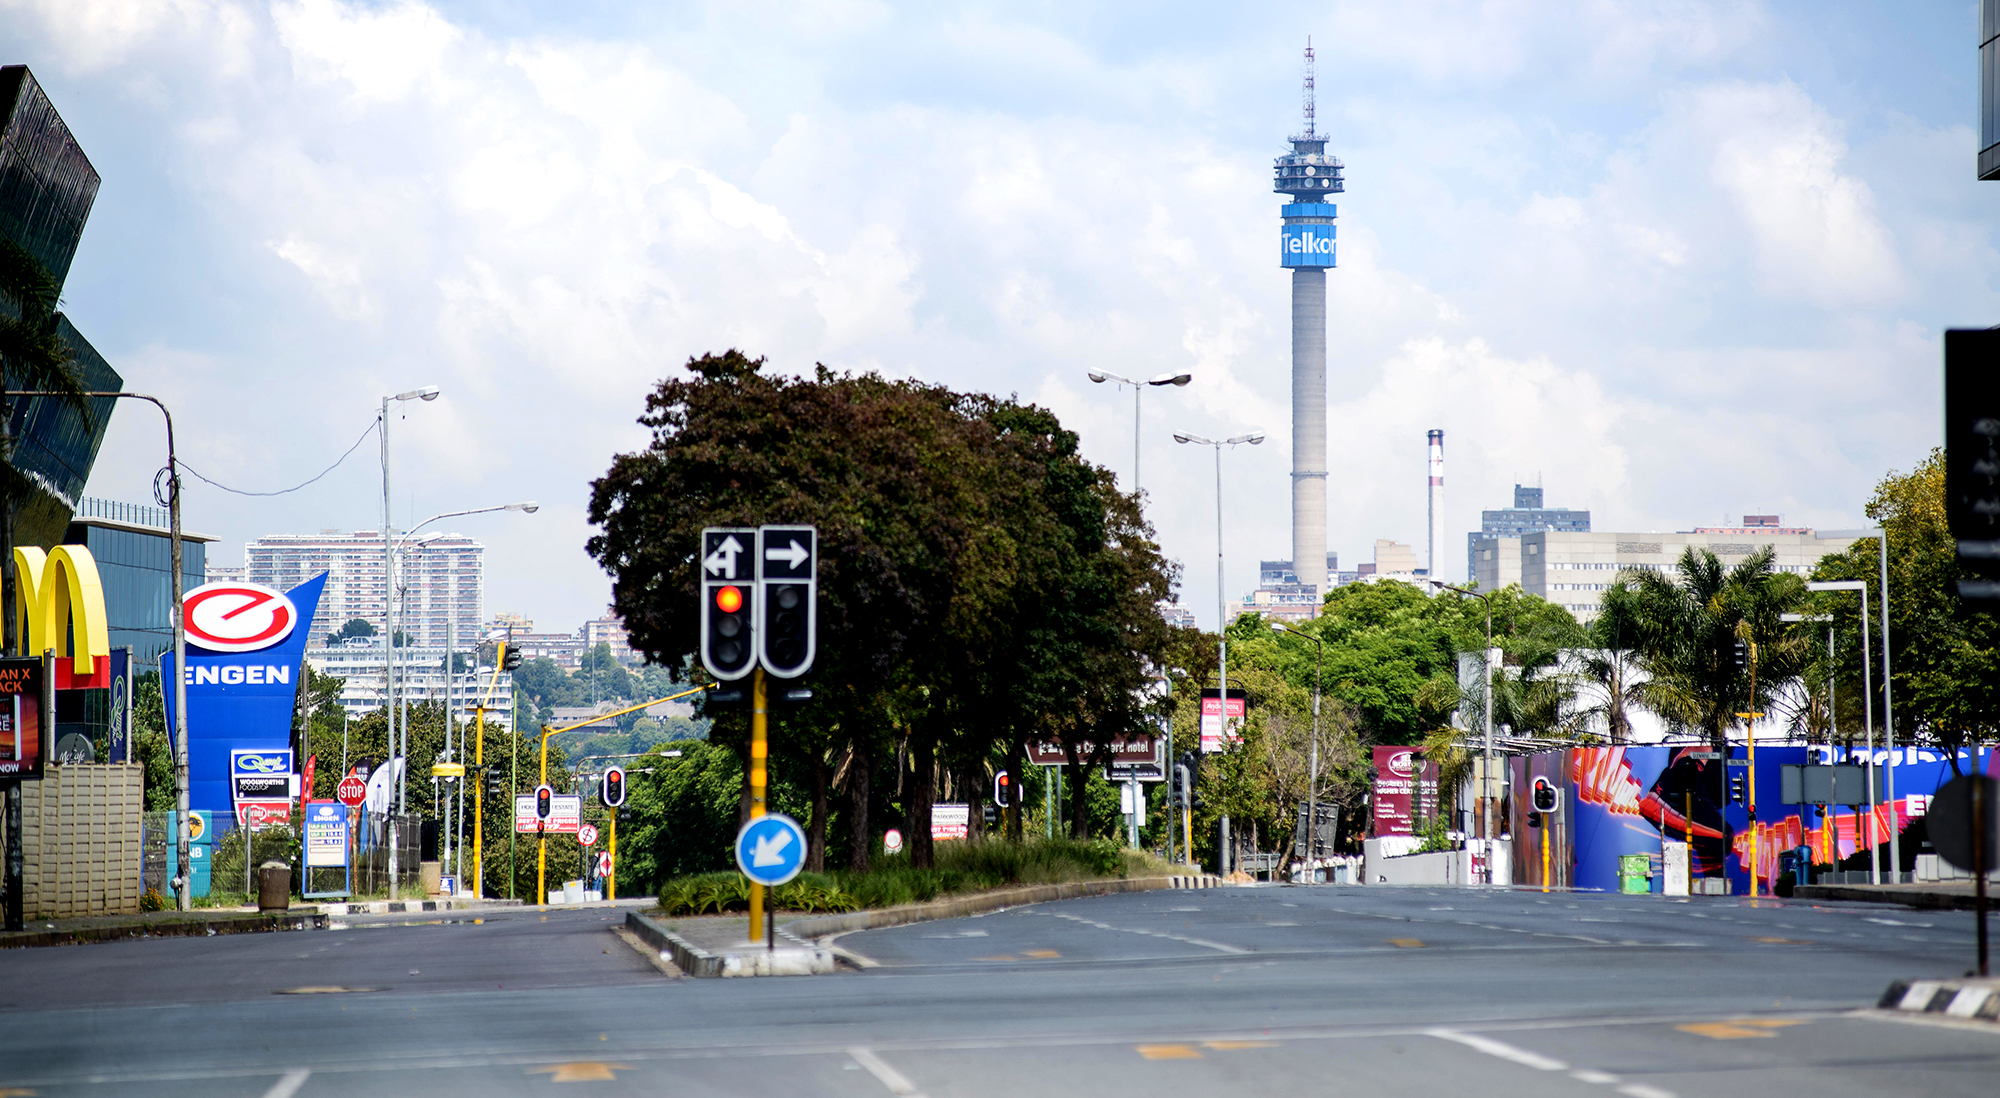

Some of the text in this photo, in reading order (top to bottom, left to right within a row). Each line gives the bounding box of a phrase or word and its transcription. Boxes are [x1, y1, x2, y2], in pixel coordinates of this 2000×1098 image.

[22, 668, 31, 680] X
[240, 778, 285, 786] WOOLWORTHS
[340, 786, 364, 798] STOP
